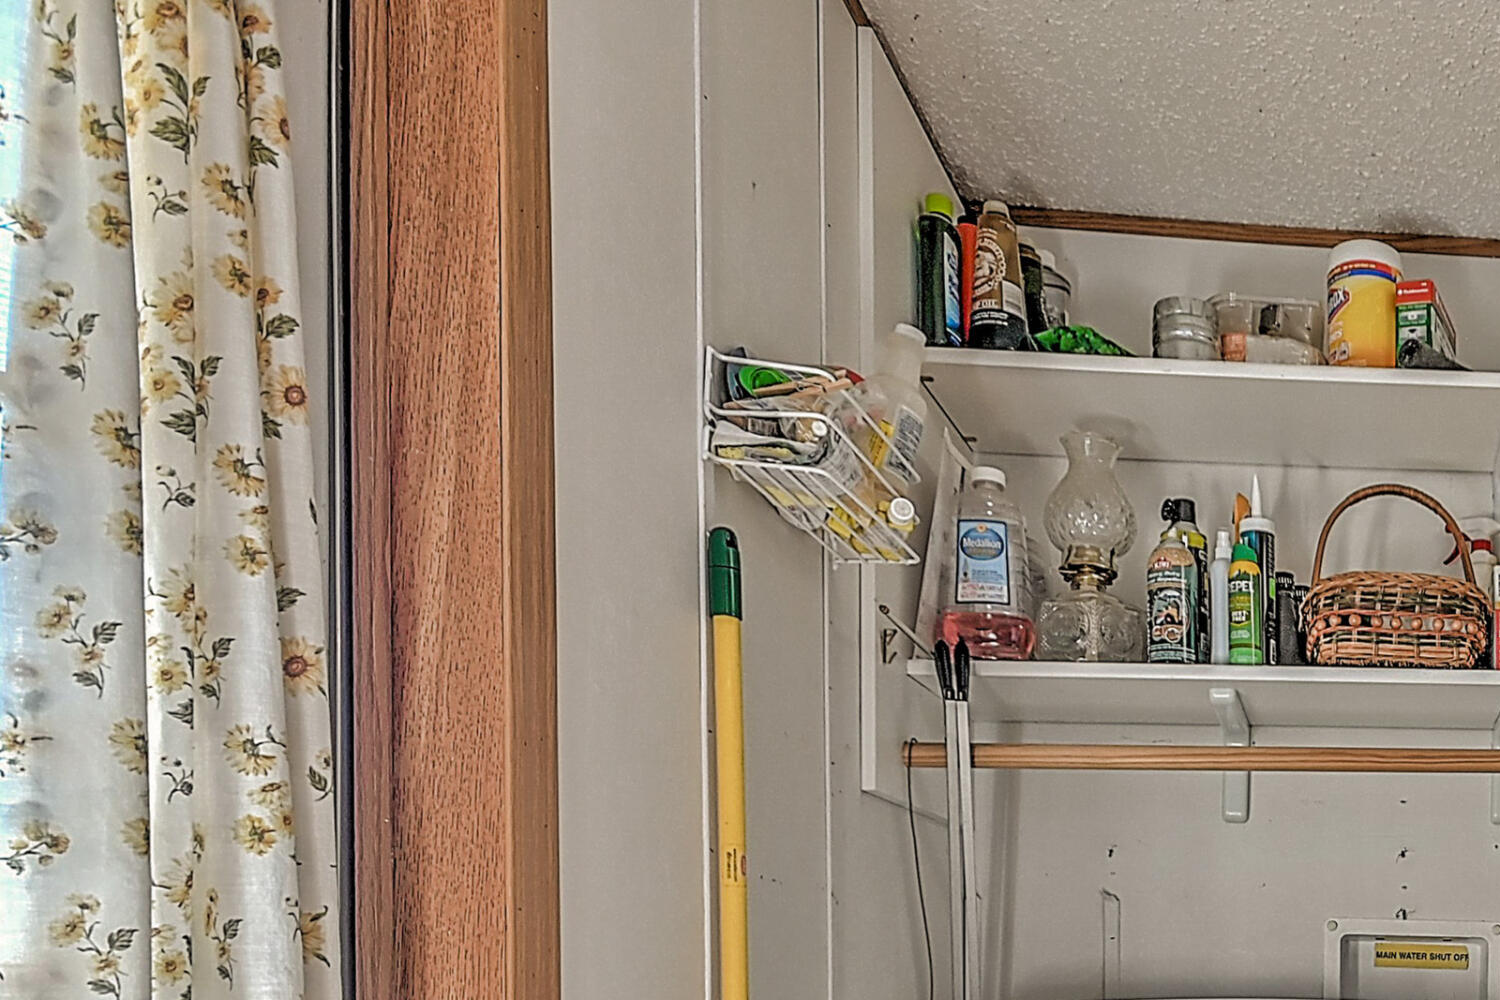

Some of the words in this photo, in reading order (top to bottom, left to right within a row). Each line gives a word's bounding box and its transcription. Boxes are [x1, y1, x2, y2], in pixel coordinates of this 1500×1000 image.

[1376, 951, 1397, 959] MAIN
[1399, 952, 1427, 960] WATER
[1429, 953, 1451, 961] SHUT
[1453, 953, 1469, 961] OFF
